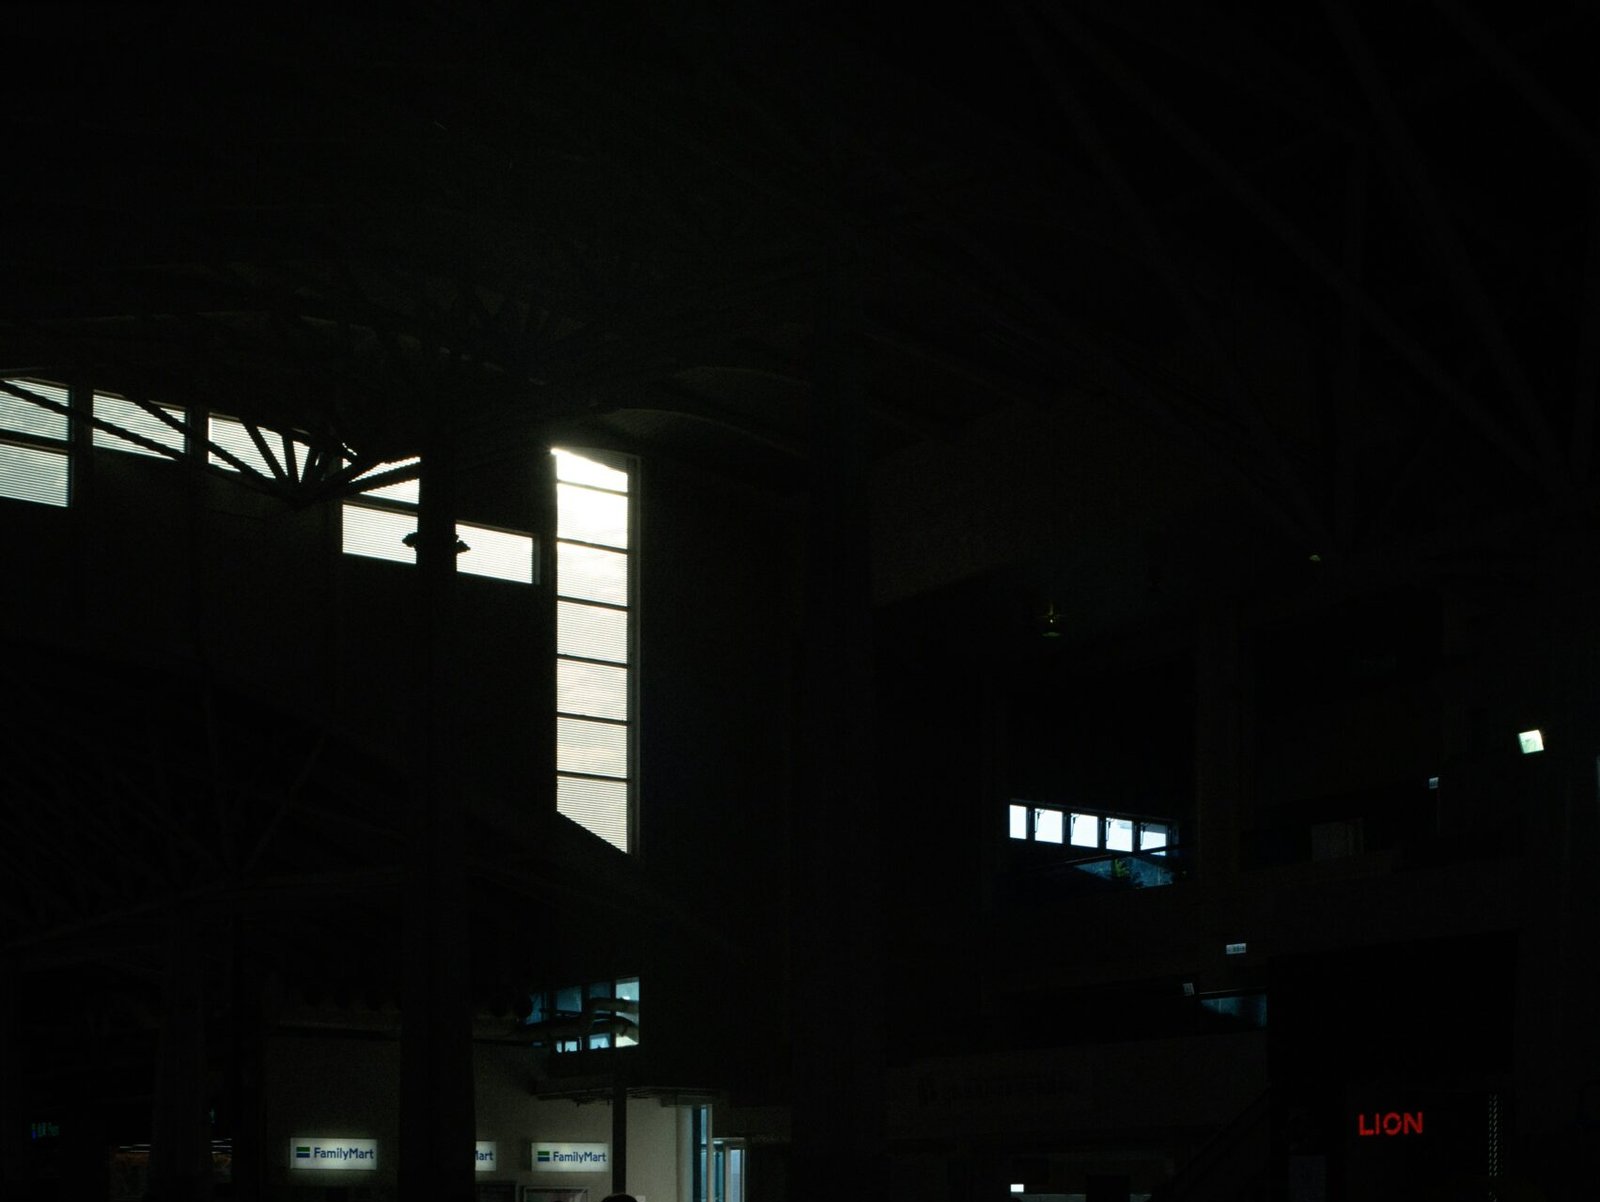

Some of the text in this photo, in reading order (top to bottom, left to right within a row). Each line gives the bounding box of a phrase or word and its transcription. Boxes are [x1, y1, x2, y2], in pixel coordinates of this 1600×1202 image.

[1359, 1111, 1423, 1136] LION
[314, 1147, 374, 1160] FamilyMart
[553, 1151, 607, 1163] FamilyMart
